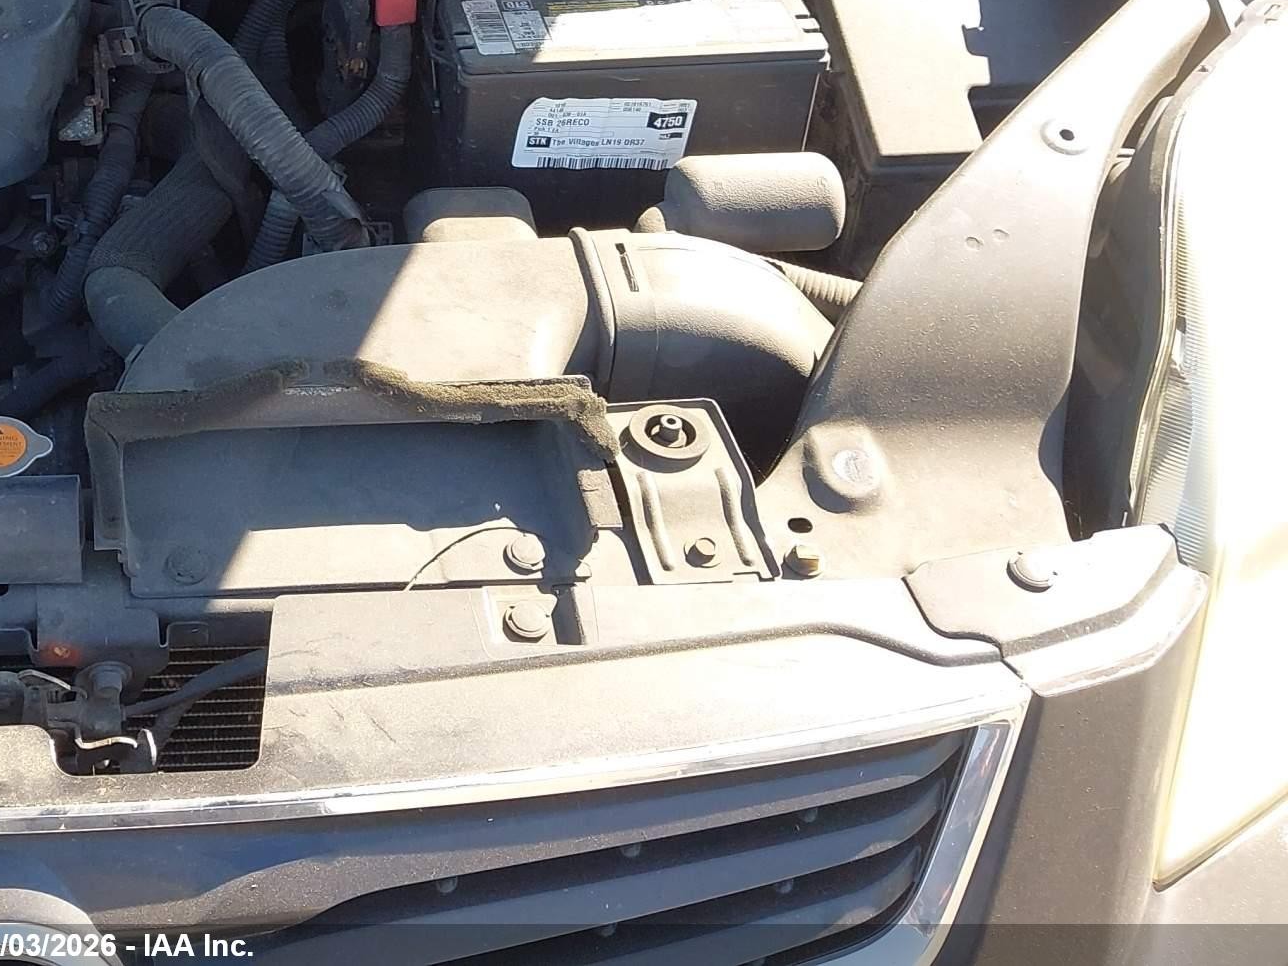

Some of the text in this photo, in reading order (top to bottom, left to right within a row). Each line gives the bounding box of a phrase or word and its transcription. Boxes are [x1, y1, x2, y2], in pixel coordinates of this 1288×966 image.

[654, 116, 683, 128] 4750
[528, 137, 547, 146] STK
[568, 138, 600, 147] Villages
